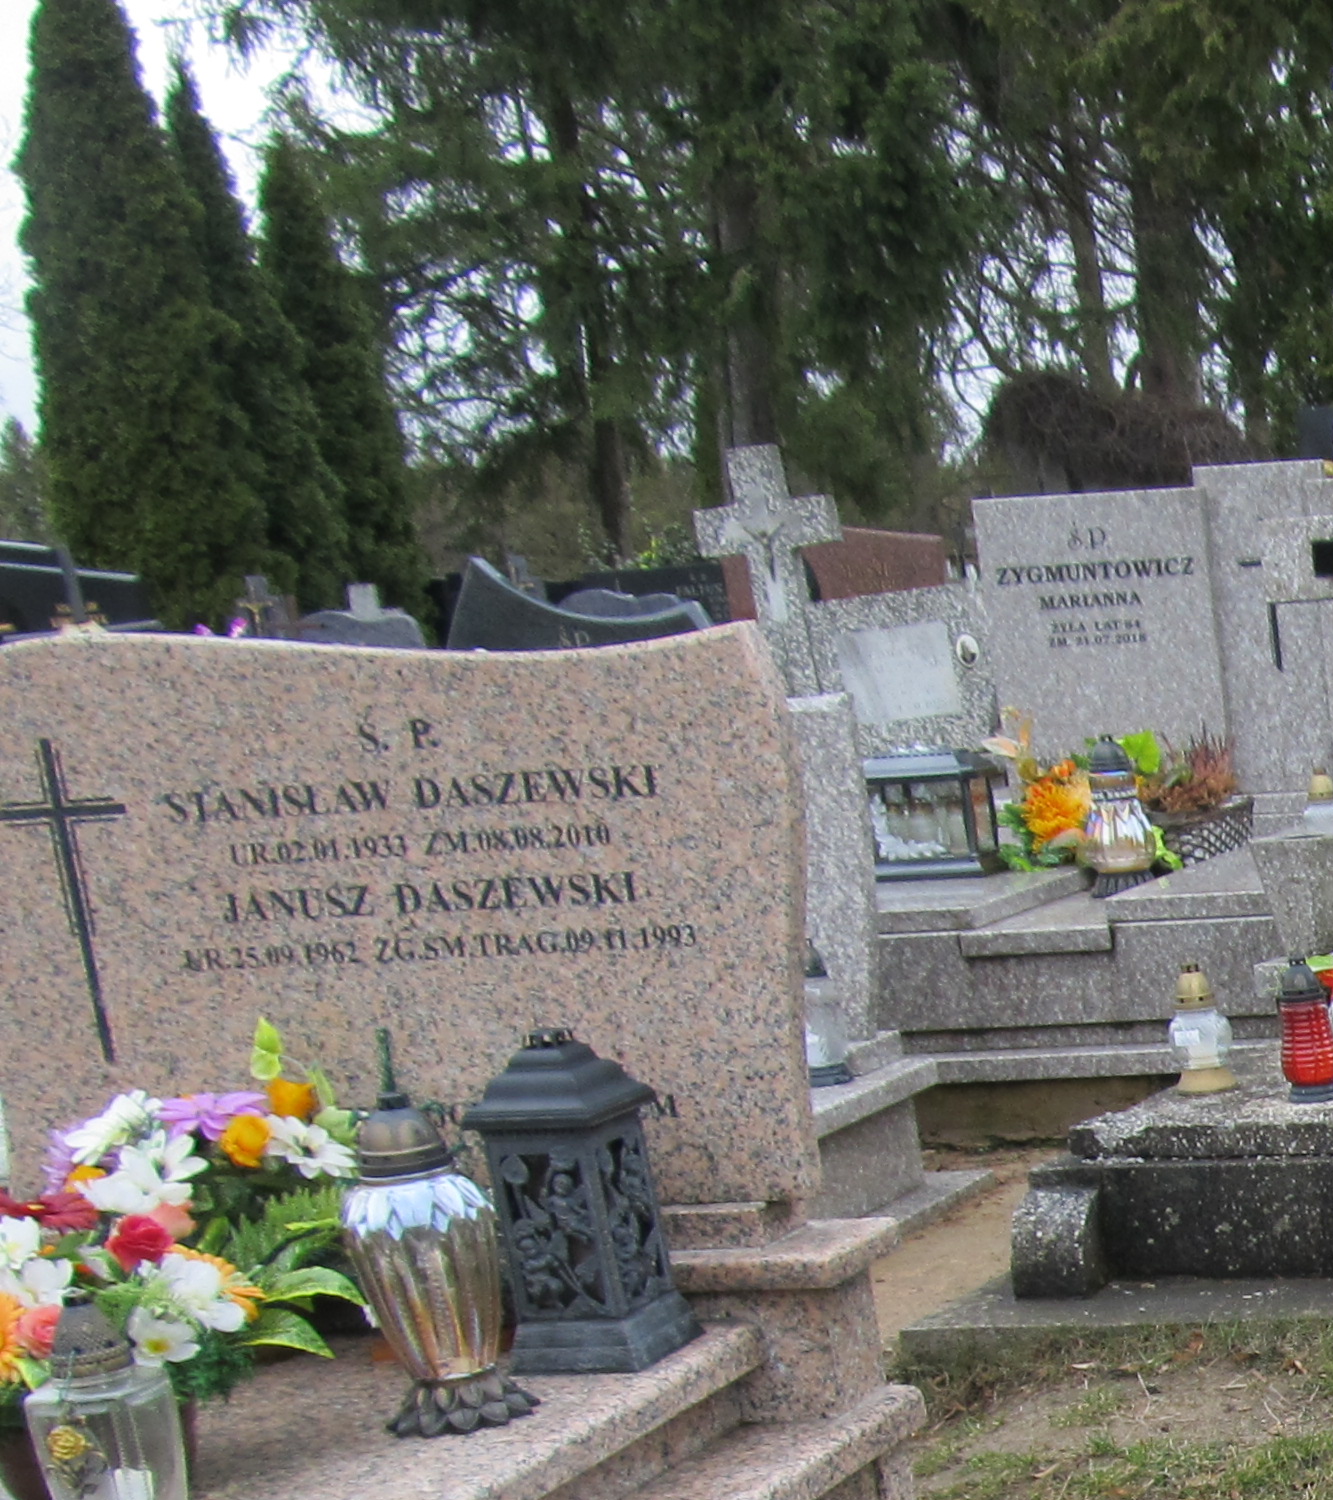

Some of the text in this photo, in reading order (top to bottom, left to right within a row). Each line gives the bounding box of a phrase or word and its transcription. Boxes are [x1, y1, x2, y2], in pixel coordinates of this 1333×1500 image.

[997, 556, 1194, 586] ZYGMUNTOWICZ
[1040, 591, 1142, 610] MARIANNA
[163, 764, 660, 823] STANISŁAW DASZEWSKI
[223, 871, 638, 924] JANUSZ DASZEWSKI
